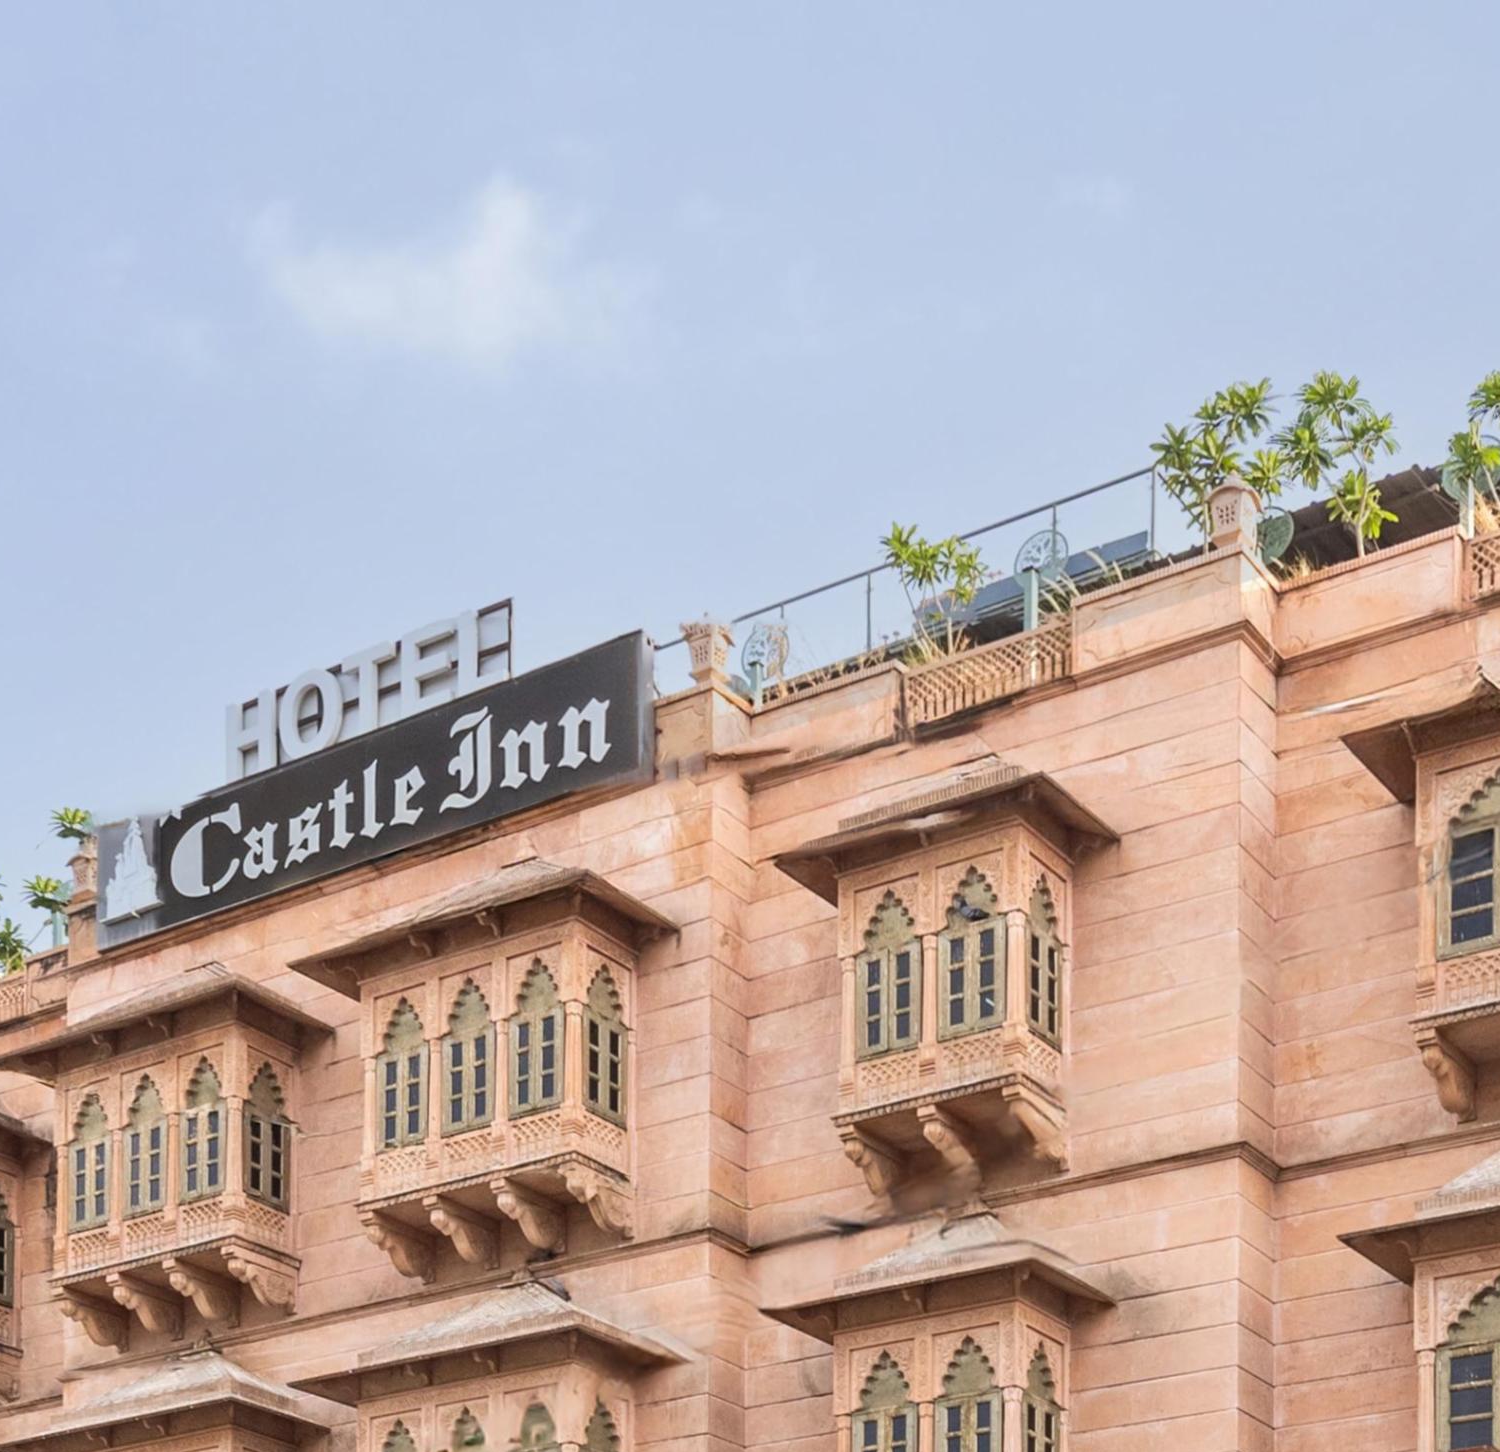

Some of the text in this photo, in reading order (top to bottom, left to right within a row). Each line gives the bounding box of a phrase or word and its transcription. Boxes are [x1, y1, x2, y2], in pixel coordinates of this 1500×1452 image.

[228, 609, 510, 780] HOTEL
[169, 697, 612, 899] Castle Inn
